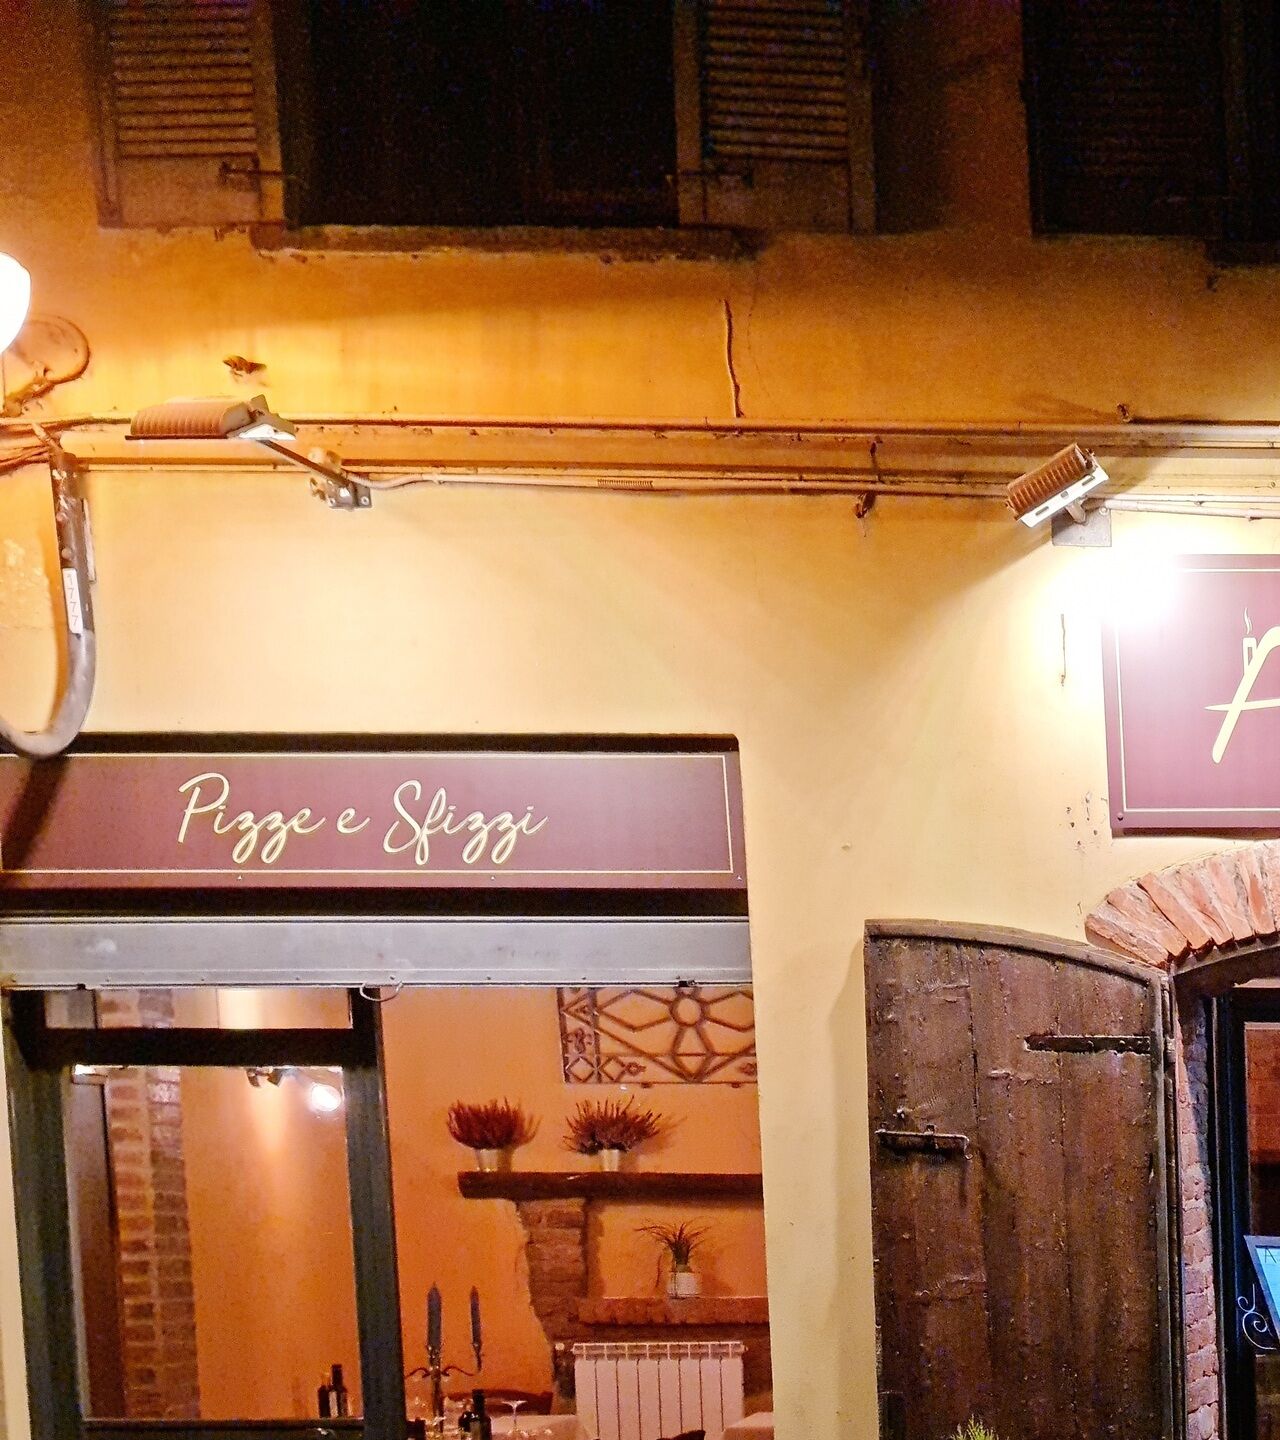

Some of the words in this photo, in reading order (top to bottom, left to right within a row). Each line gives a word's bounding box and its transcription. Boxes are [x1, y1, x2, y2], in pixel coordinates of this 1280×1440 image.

[177, 772, 325, 864] Pizze
[336, 807, 371, 834] e
[383, 780, 549, 865] Sfizzi
